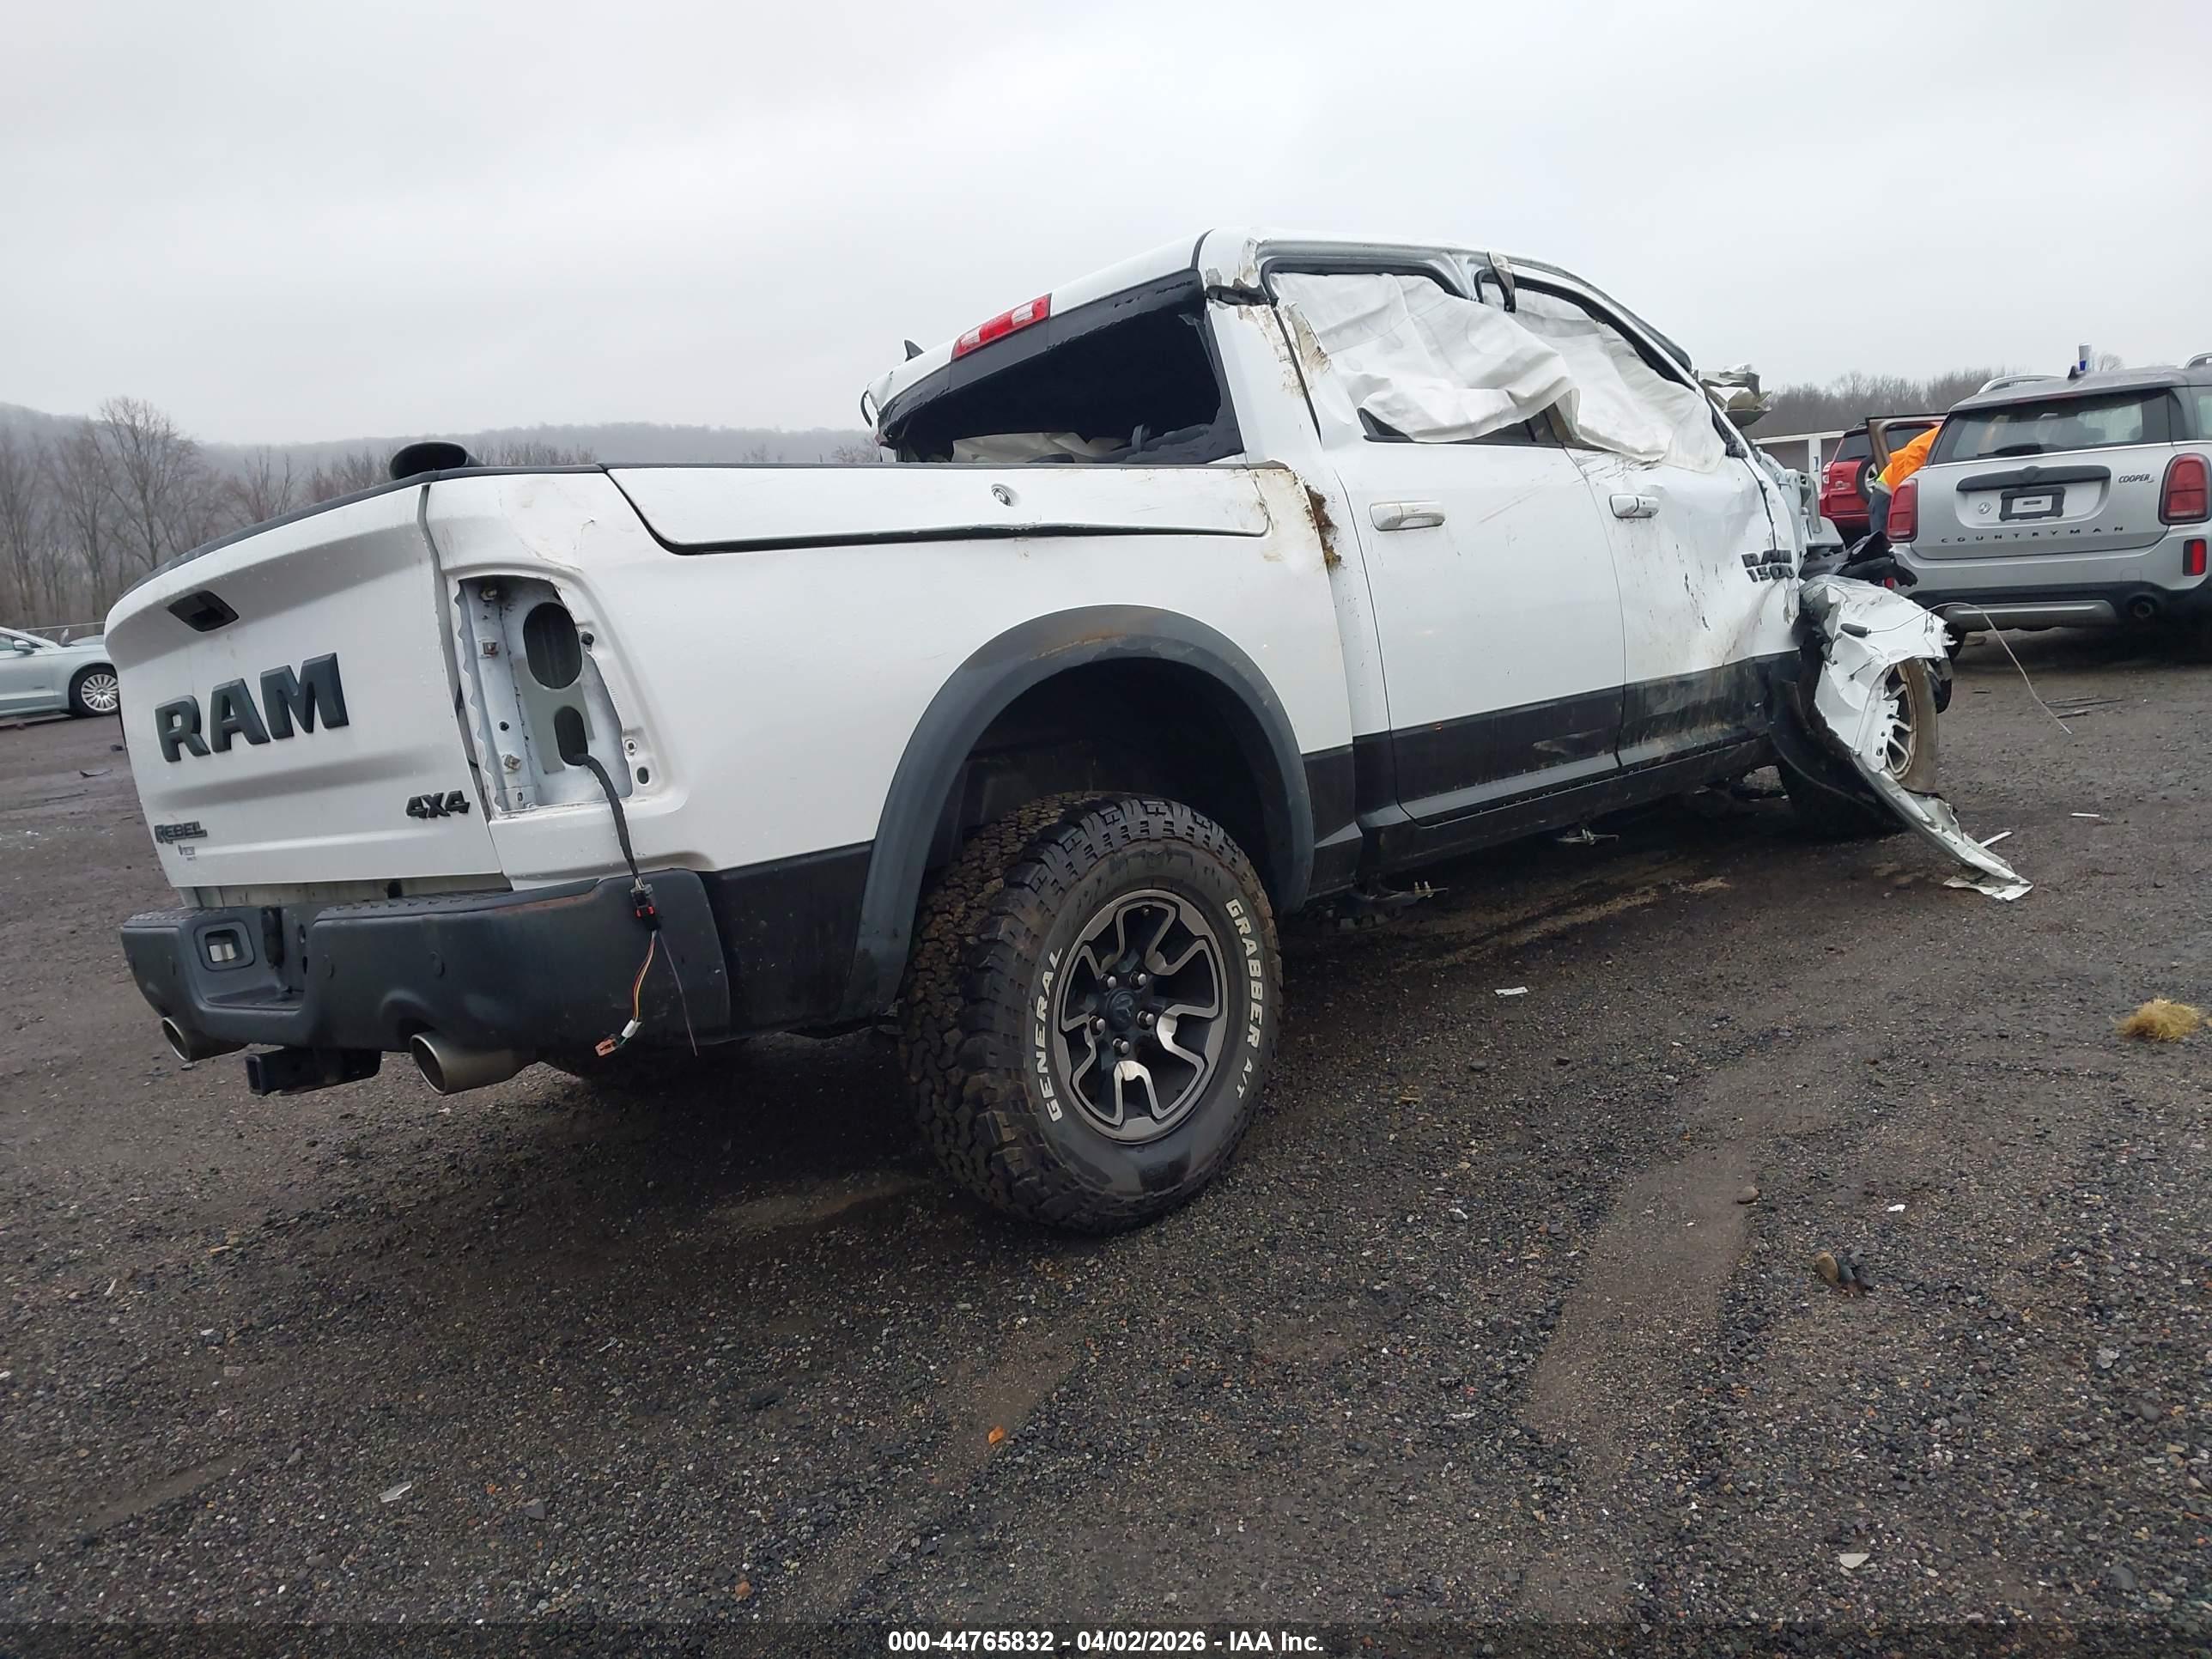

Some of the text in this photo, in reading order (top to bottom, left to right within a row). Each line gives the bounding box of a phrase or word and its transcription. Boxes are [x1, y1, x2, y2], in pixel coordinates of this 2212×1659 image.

[2118, 473, 2151, 483] COOPER
[1941, 526, 2124, 544] COUNTRYMAN
[1741, 549, 1793, 568] RAM
[1746, 564, 1796, 583] 1500
[155, 652, 349, 763] RAM
[154, 821, 208, 845] REBEL
[1224, 897, 1263, 1099] GRABBER A/T
[1034, 947, 1063, 1122] GENERAL
